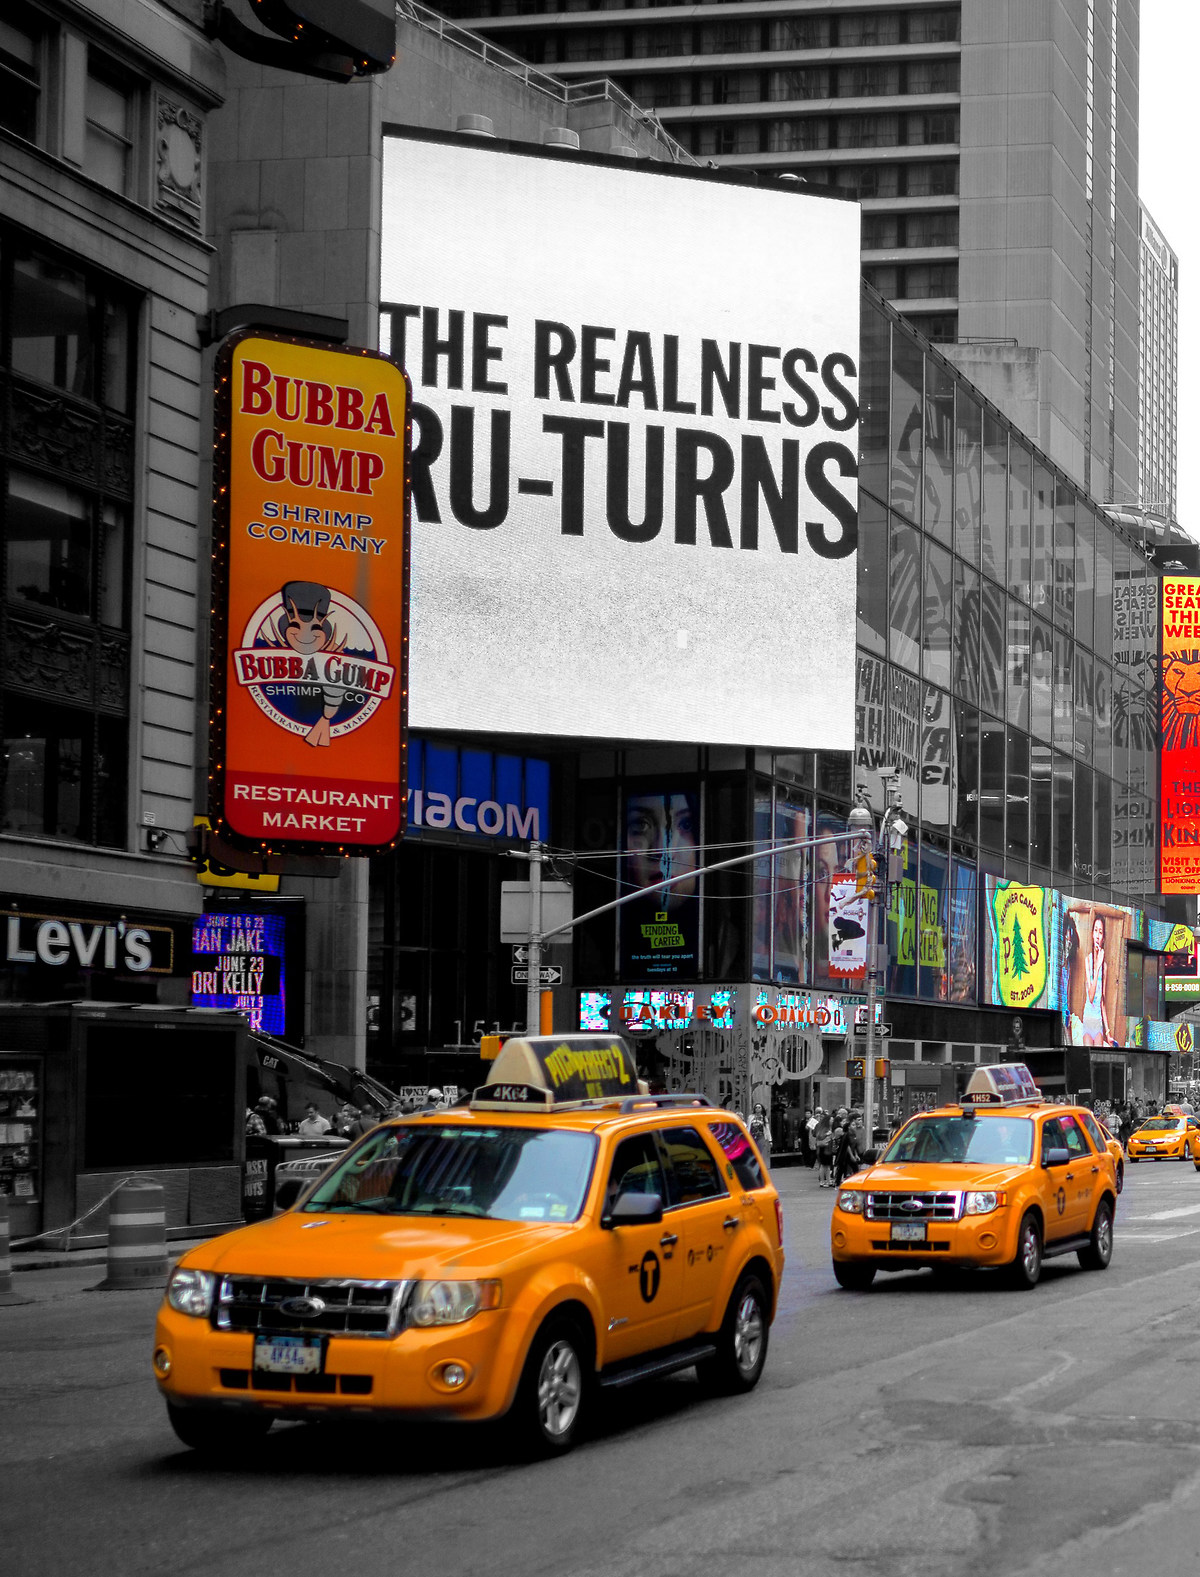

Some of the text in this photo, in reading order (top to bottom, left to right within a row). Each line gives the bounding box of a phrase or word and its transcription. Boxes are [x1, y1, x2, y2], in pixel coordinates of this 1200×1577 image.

[379, 301, 858, 432] THE REALNESS
[239, 359, 397, 438] BUBBA
[251, 428, 384, 496] GUMP
[411, 401, 858, 560] RU-TURNS
[262, 501, 373, 531] SHRIMP
[247, 522, 387, 555] COMPANY
[239, 653, 390, 693] BUBBA GUMP
[266, 685, 322, 697] SHRIMP
[251, 686, 378, 735] RESTAURANT & MARKET
[233, 784, 394, 810] RESTAURANT
[262, 810, 366, 832] MARKET
[1163, 857, 1191, 866] VISIT
[1019, 893, 1037, 917] CAMP
[226, 928, 265, 952] JAKE
[645, 925, 677, 935] FINDING
[654, 936, 680, 947] CARTER
[1003, 928, 1039, 975] P S
[215, 956, 265, 972] JUNE 23
[222, 972, 264, 994] KELLY
[1021, 984, 1035, 1000] 2009
[236, 996, 256, 1008] JULY
[619, 1005, 729, 1020] OAKLEY
[780, 1005, 827, 1025] OAKLEY
[263, 1055, 279, 1070] CAT
[971, 1094, 991, 1103] 1H52
